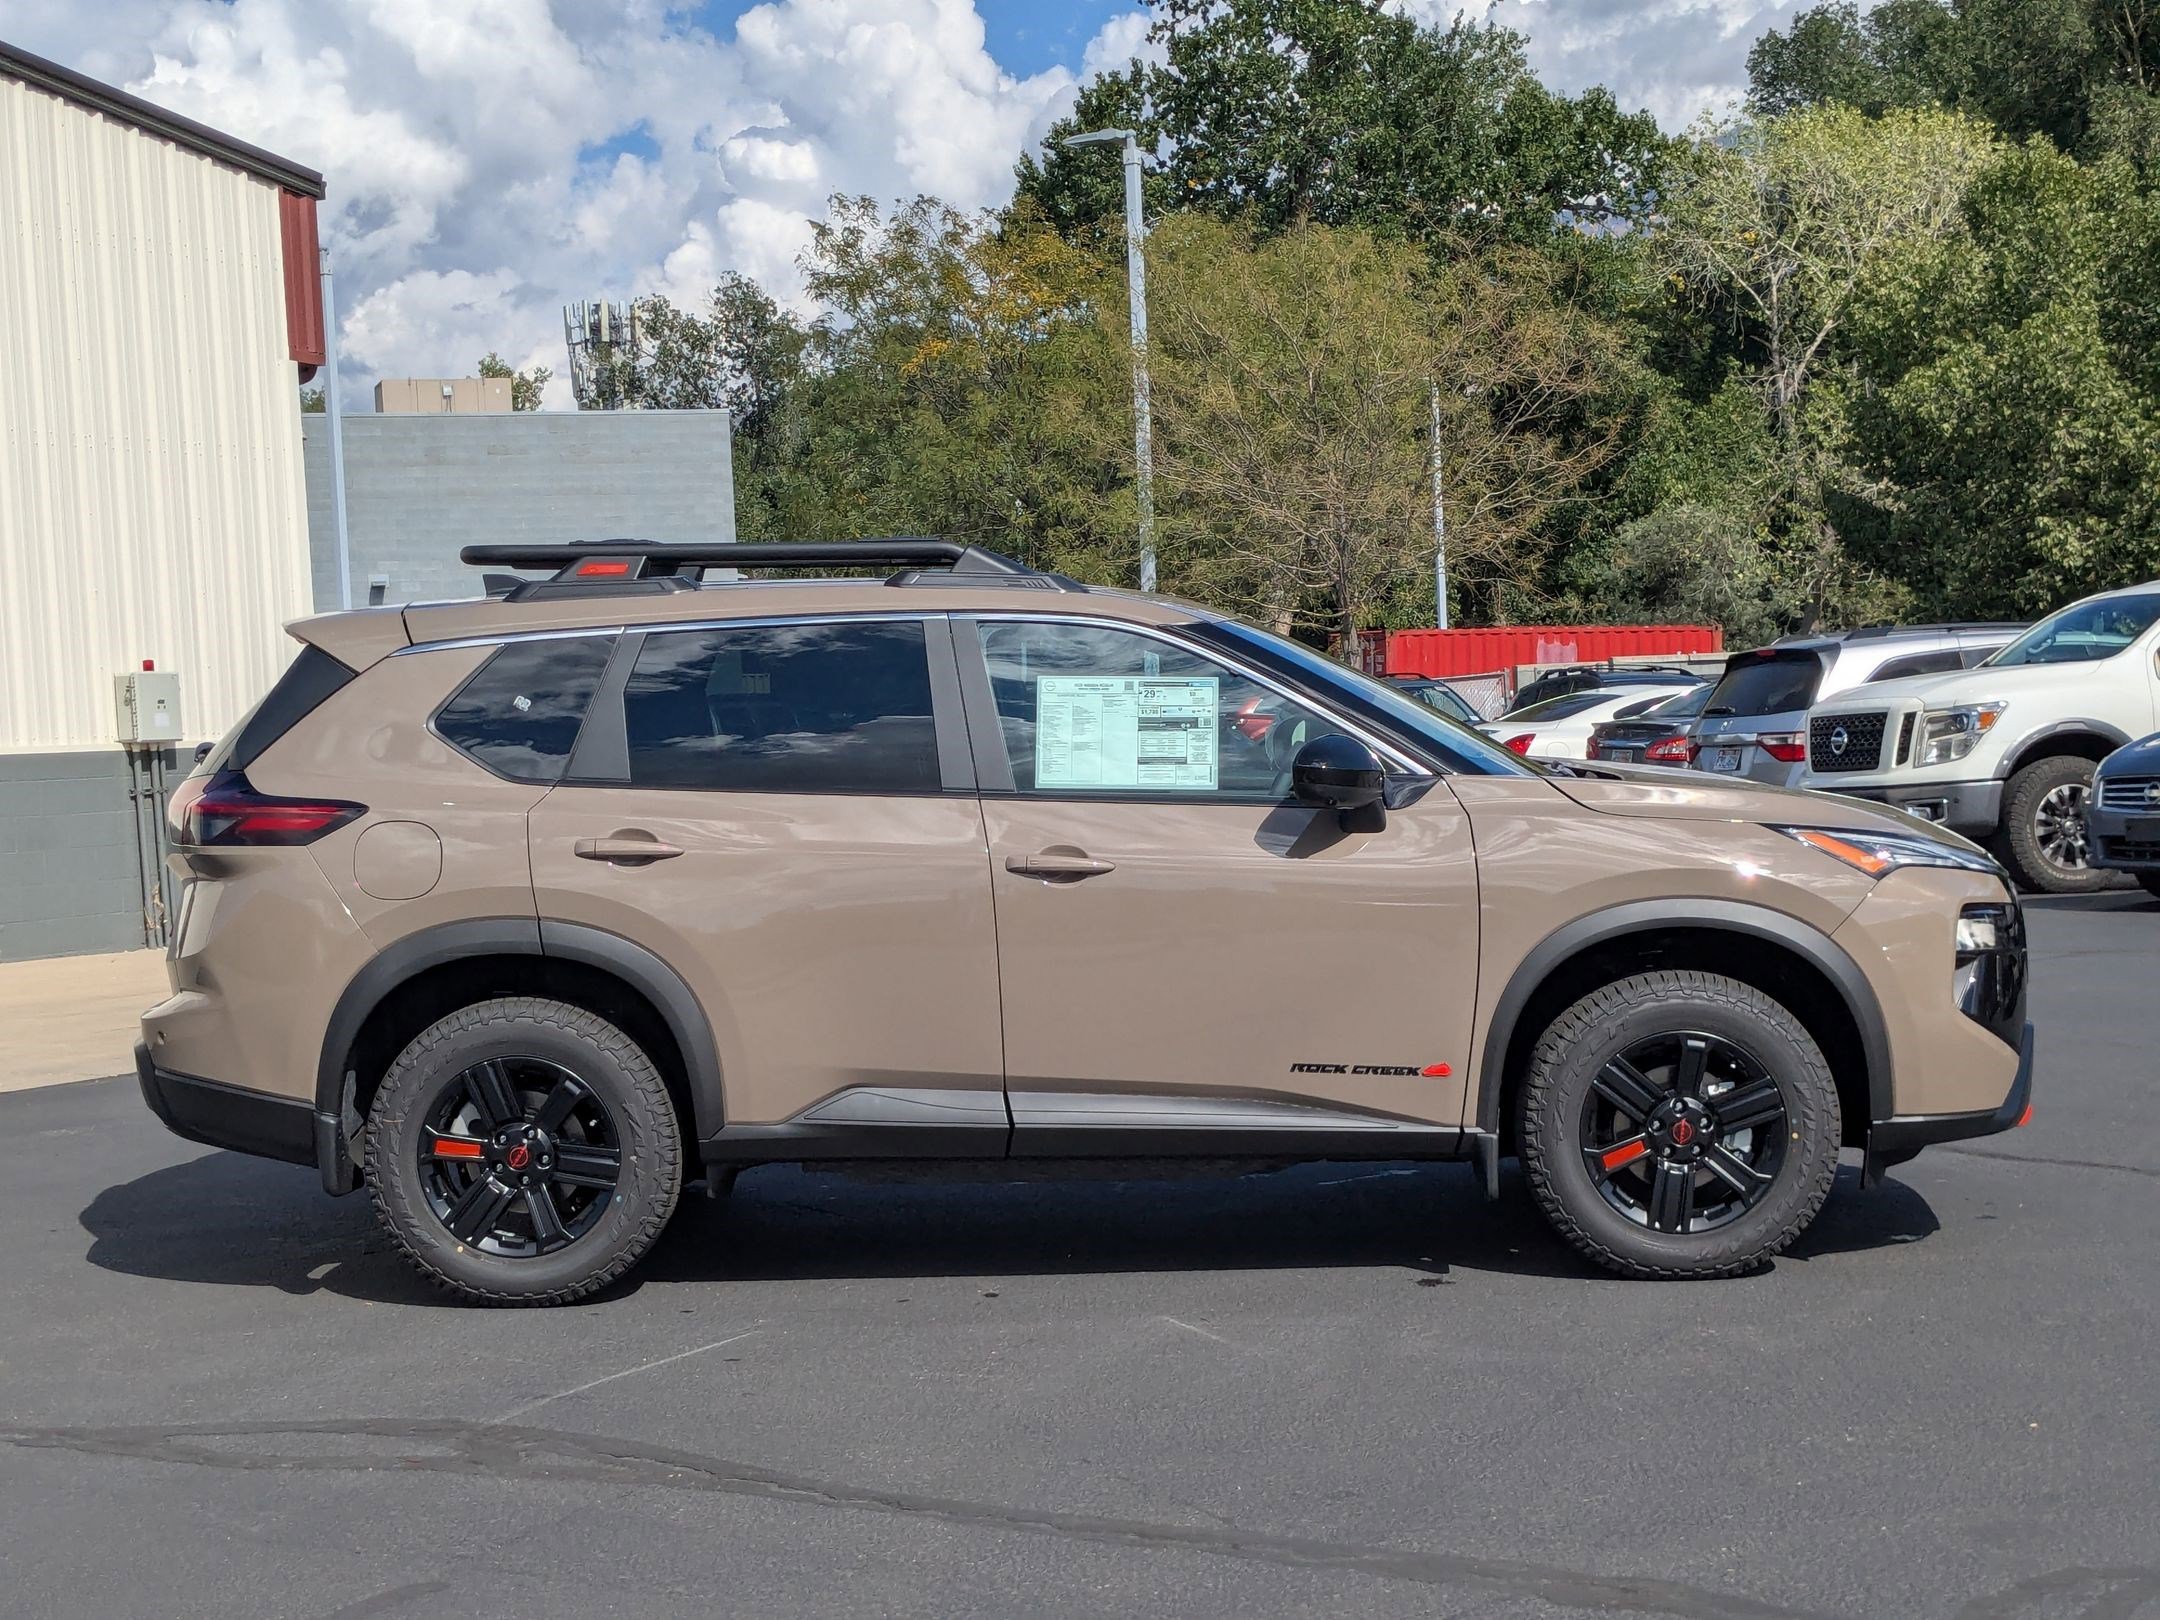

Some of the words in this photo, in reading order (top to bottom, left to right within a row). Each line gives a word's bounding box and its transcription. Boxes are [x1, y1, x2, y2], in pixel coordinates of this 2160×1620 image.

[1144, 690, 1156, 699] 29
[1290, 1063, 1349, 1074] ROCK
[1351, 1065, 1421, 1076] CREEK
